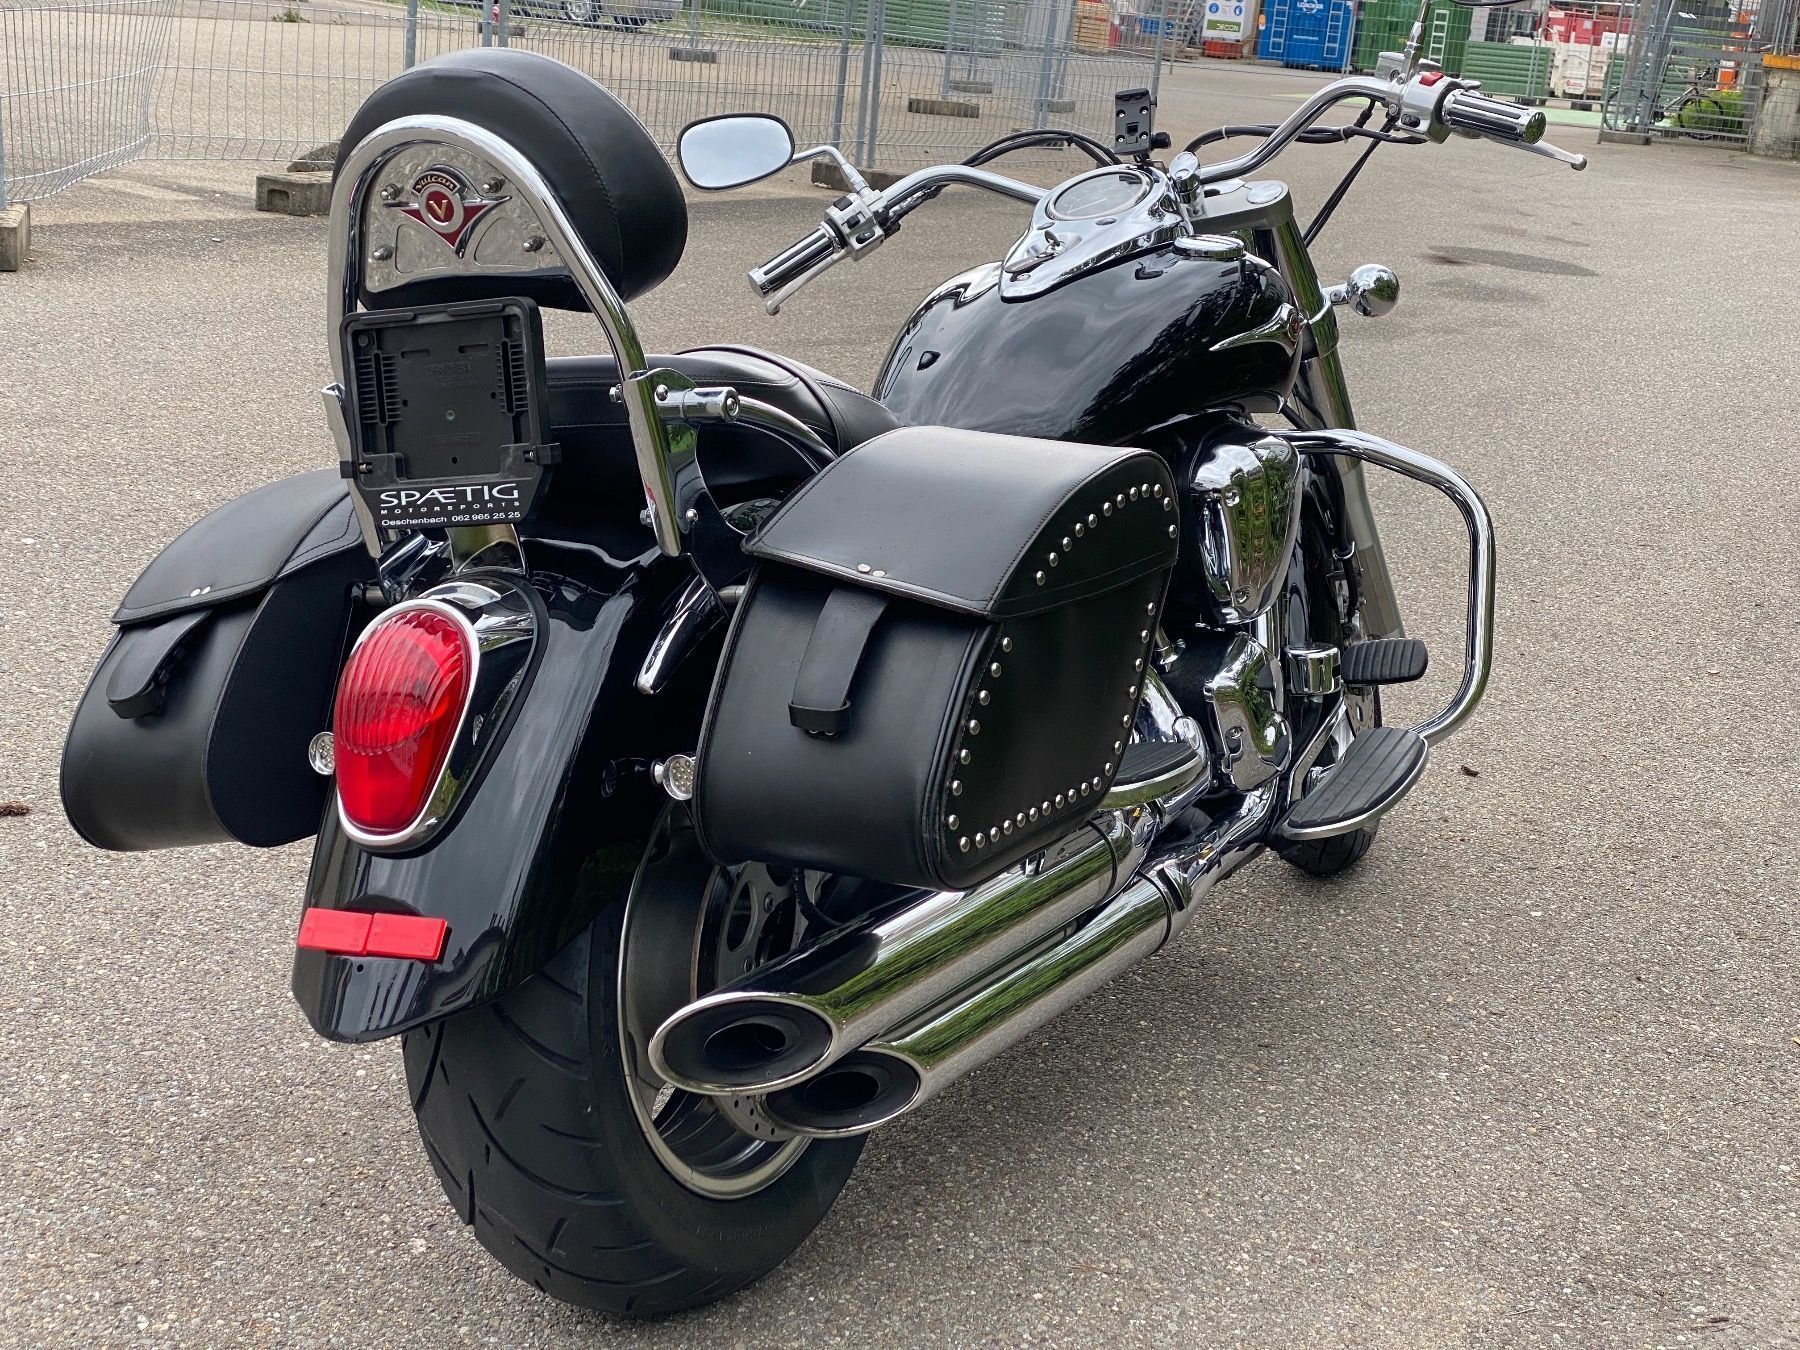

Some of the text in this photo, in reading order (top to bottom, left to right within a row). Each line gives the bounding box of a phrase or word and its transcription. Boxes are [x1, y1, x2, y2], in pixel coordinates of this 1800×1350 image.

[428, 200, 448, 220] V
[380, 483, 519, 507] SPÆTIG
[380, 501, 520, 515] MOTORSPORTS
[381, 516, 447, 526] Oeschenbach
[451, 514, 470, 522] 062
